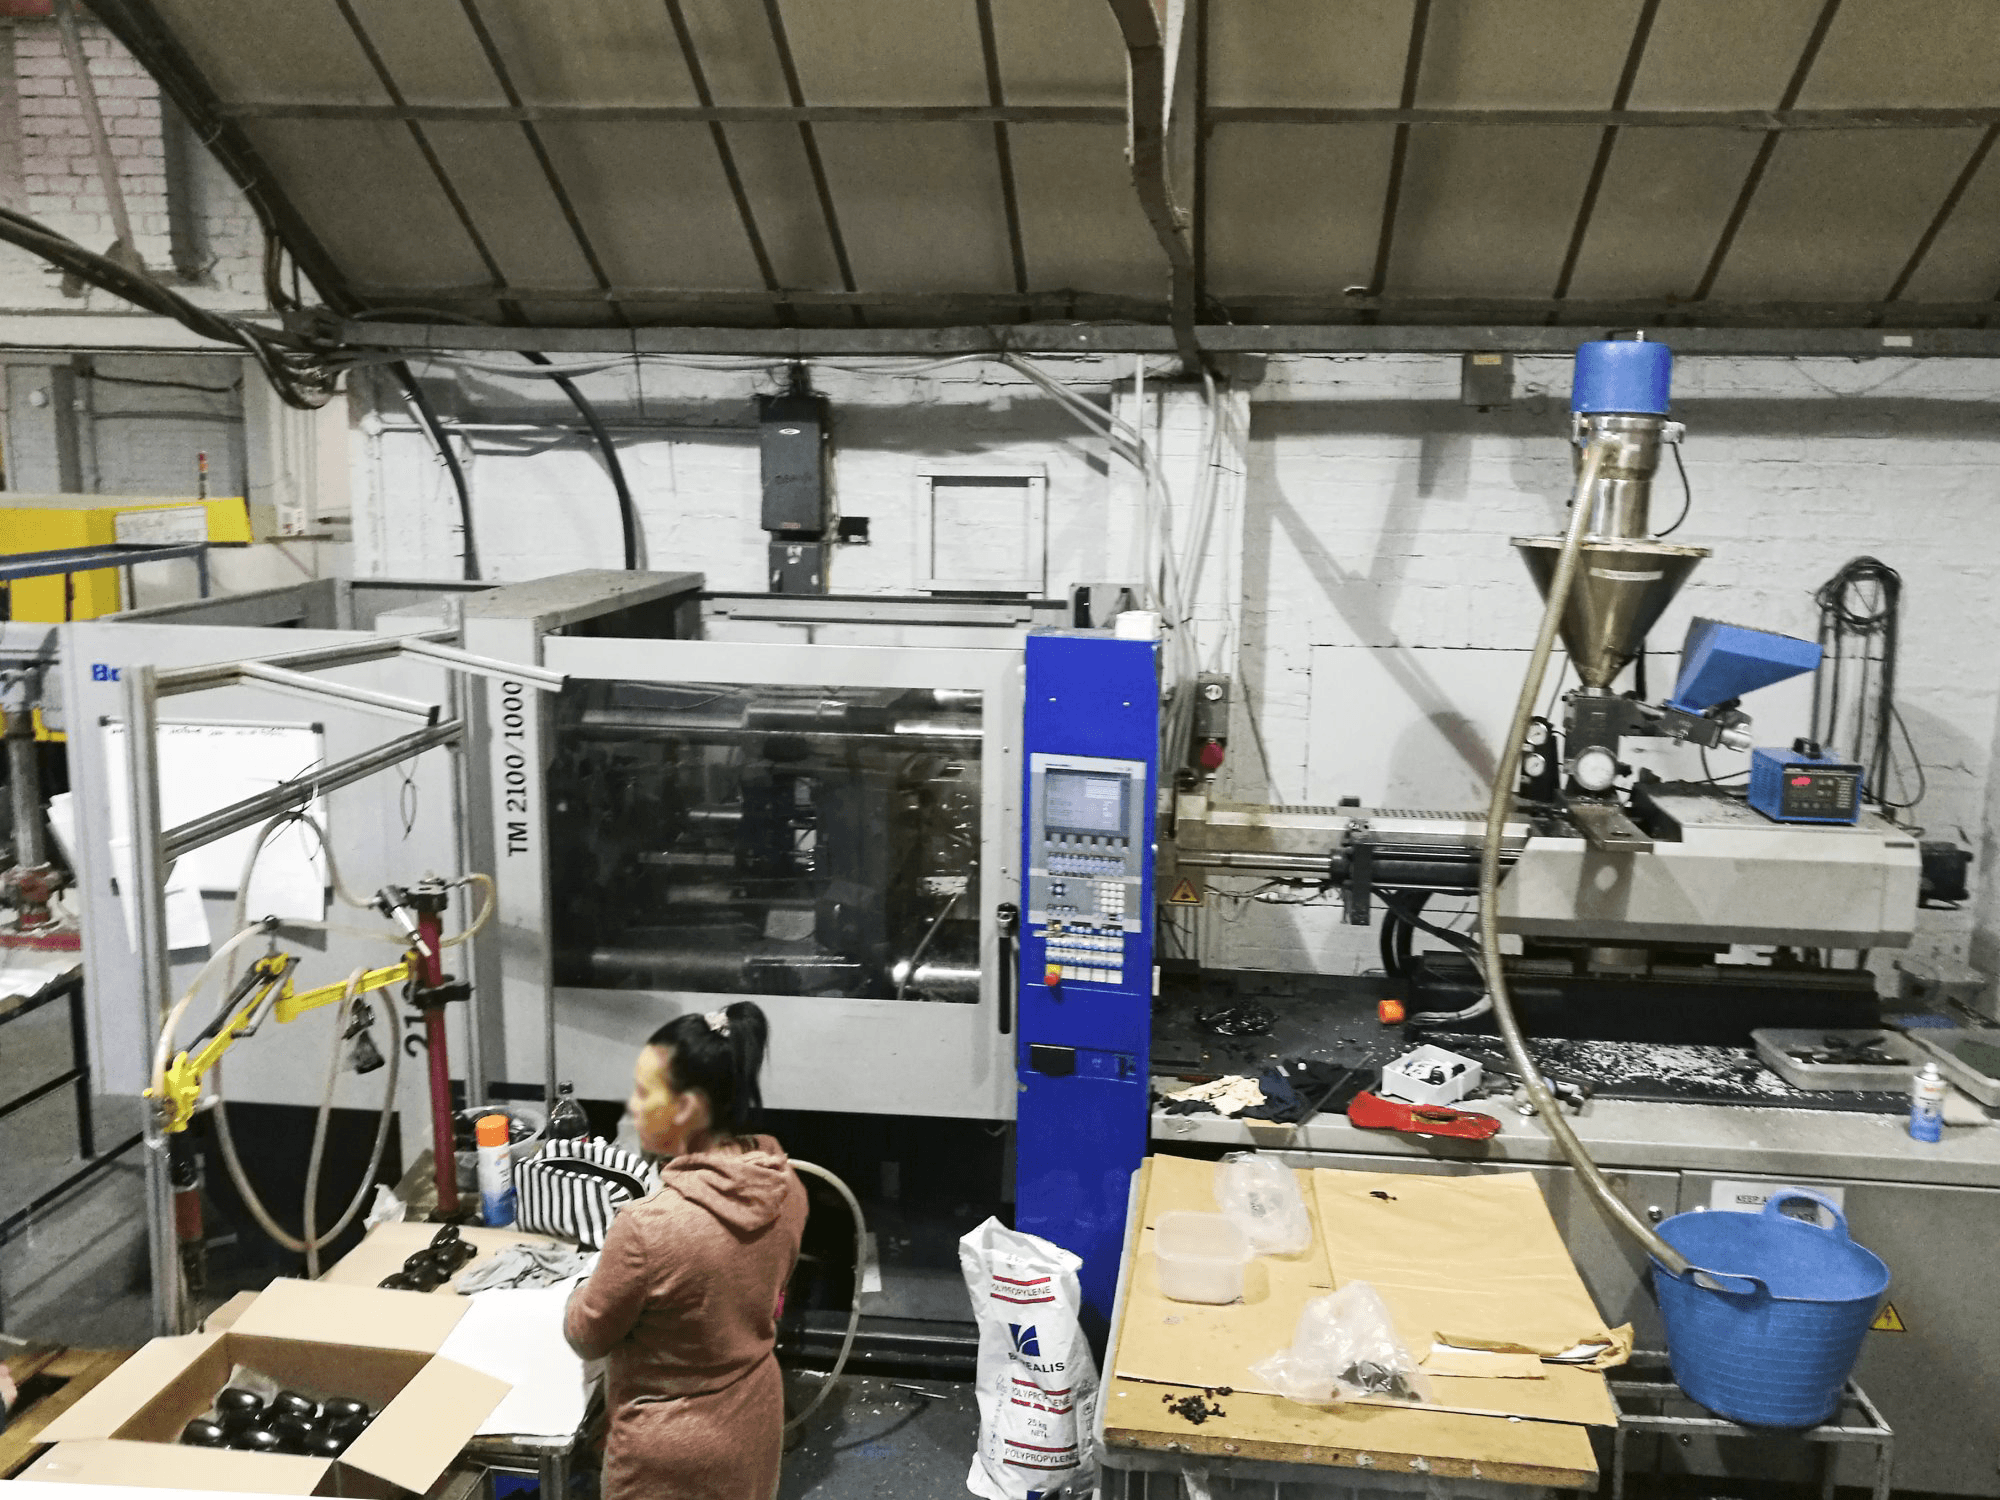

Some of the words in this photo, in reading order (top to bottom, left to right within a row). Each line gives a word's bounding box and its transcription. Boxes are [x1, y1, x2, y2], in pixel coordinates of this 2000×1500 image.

[502, 680, 527, 813] 2100/1000
[507, 821, 528, 857] TM
[1008, 1352, 1065, 1373] BEALIS
